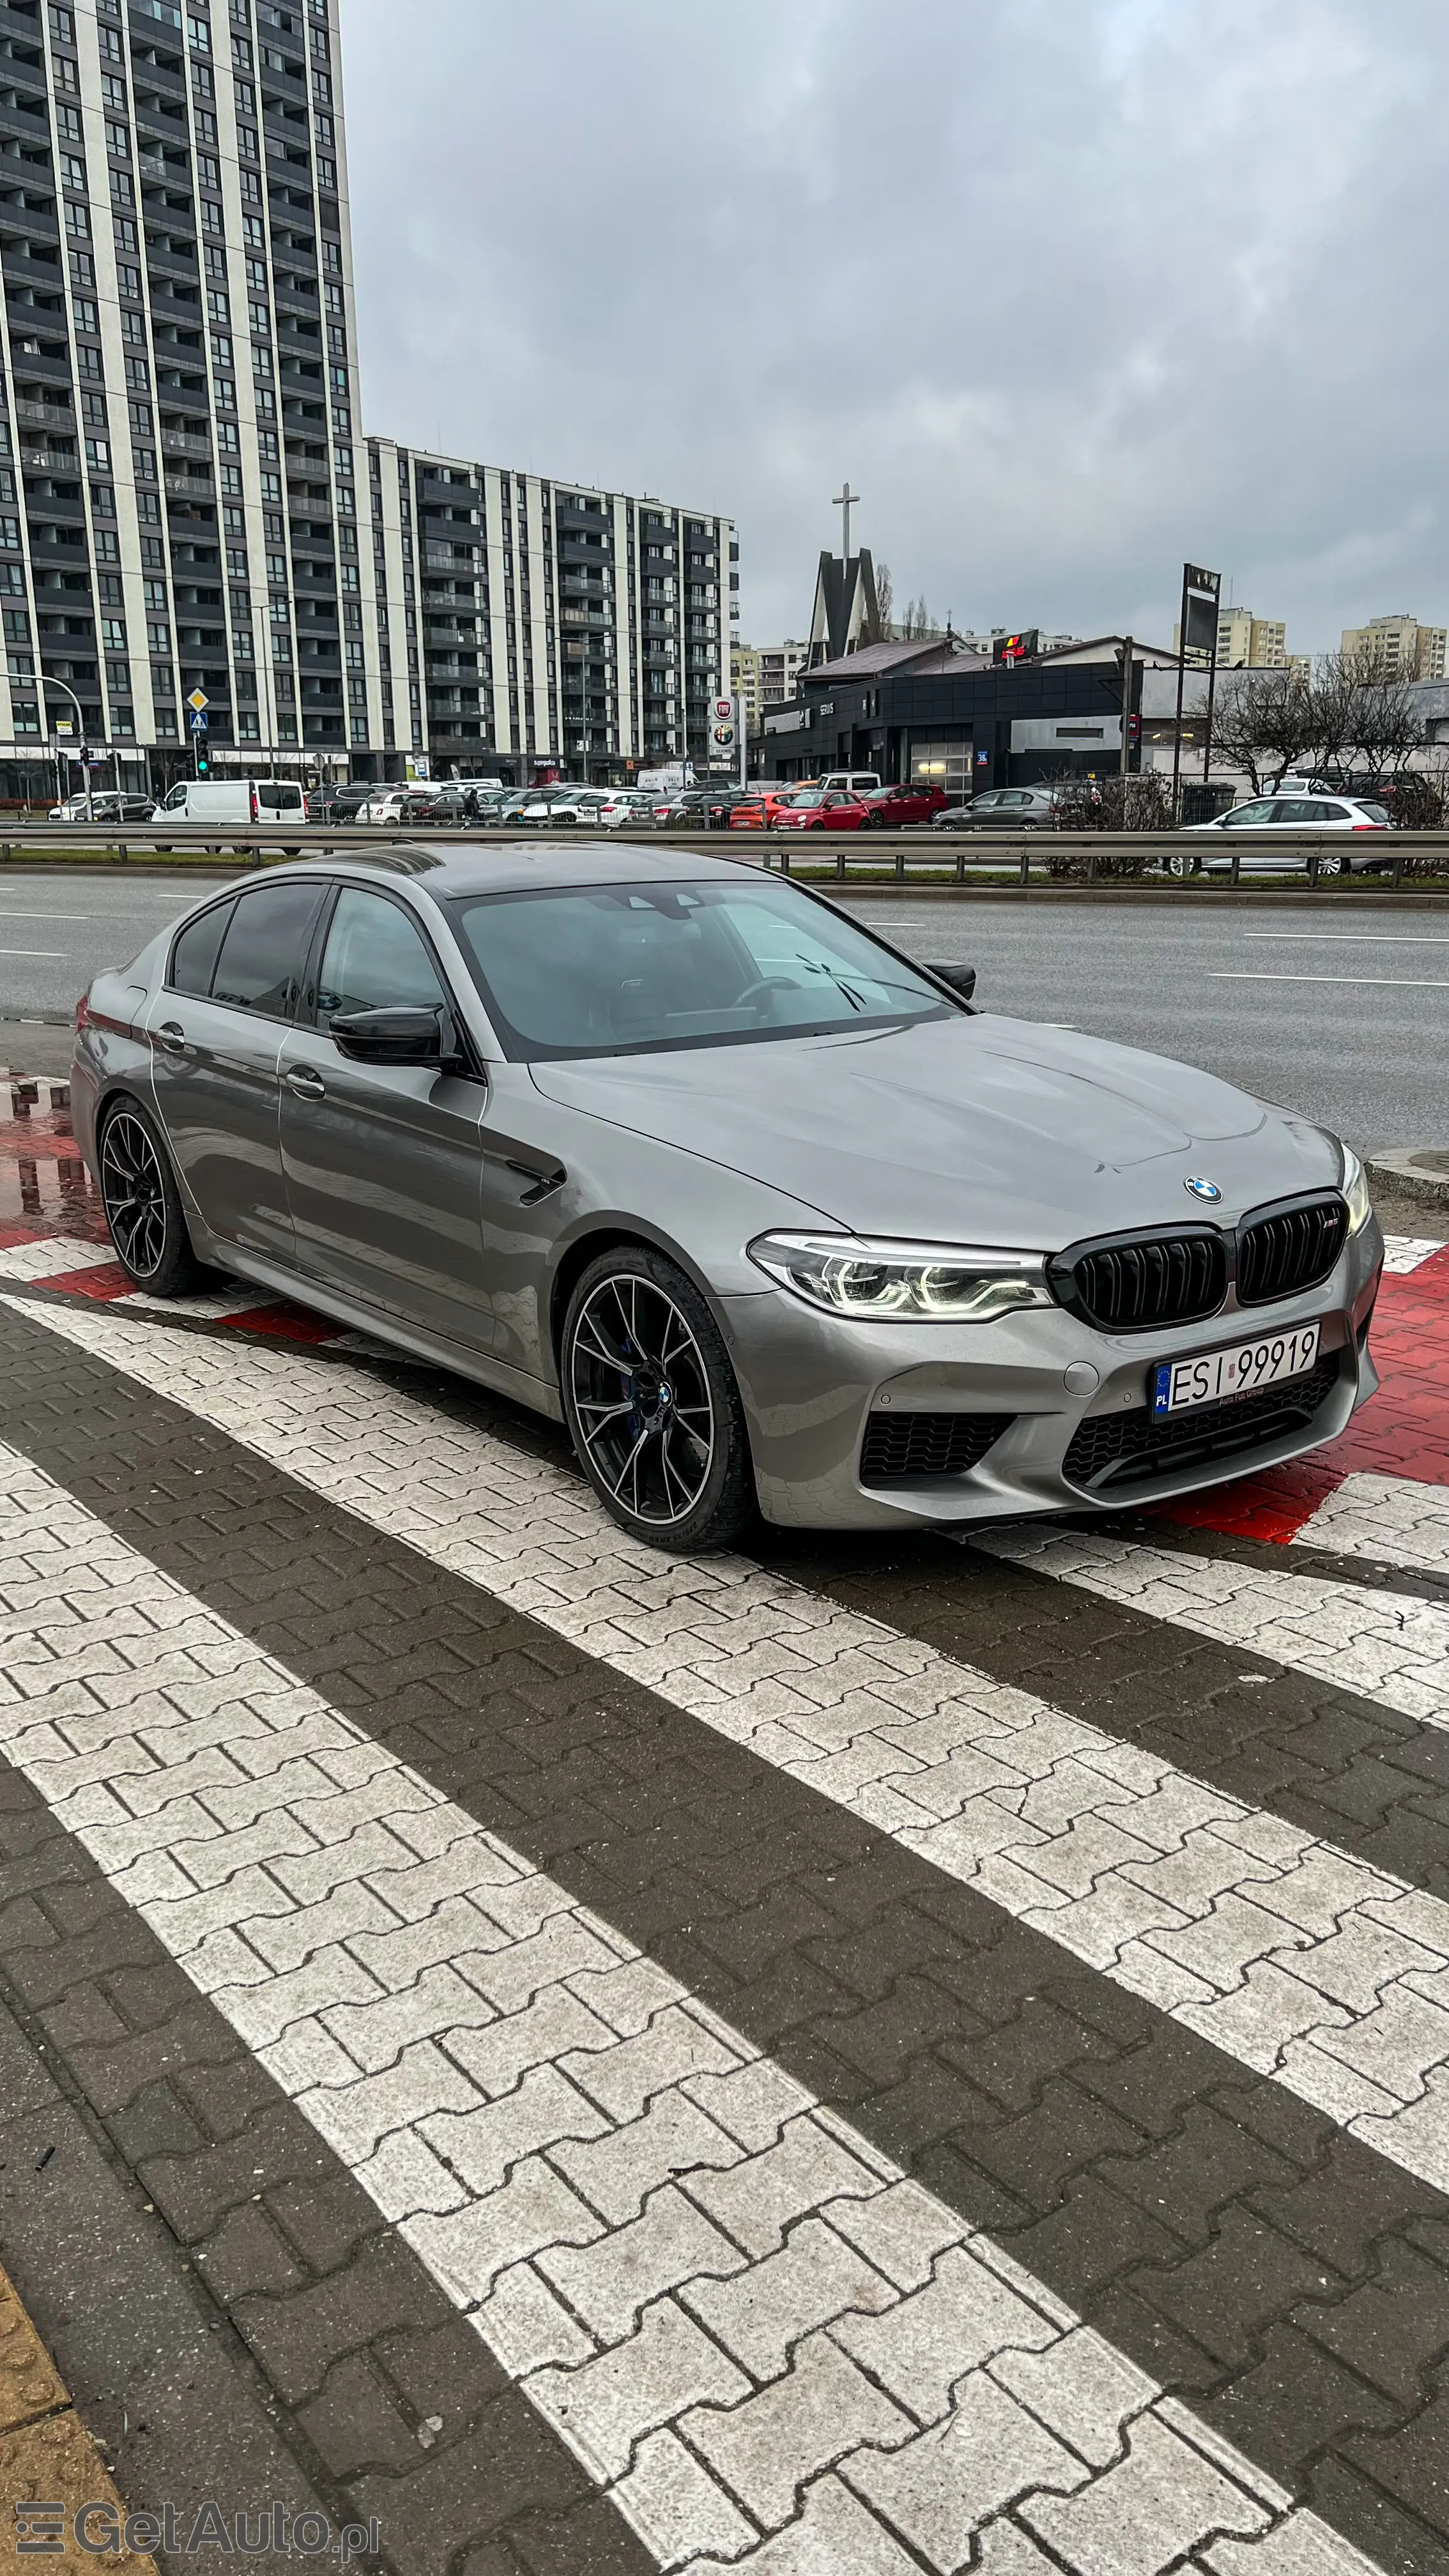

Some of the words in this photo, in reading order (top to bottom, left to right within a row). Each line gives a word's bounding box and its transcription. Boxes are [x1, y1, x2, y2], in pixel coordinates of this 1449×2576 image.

[1172, 1356, 1223, 1406] ESI
[1236, 1330, 1315, 1389] 99919
[1155, 1395, 1167, 1407] PL
[1219, 1397, 1234, 1406] Auto
[1234, 1392, 1246, 1402] Fus
[1246, 1387, 1264, 1397] Group
